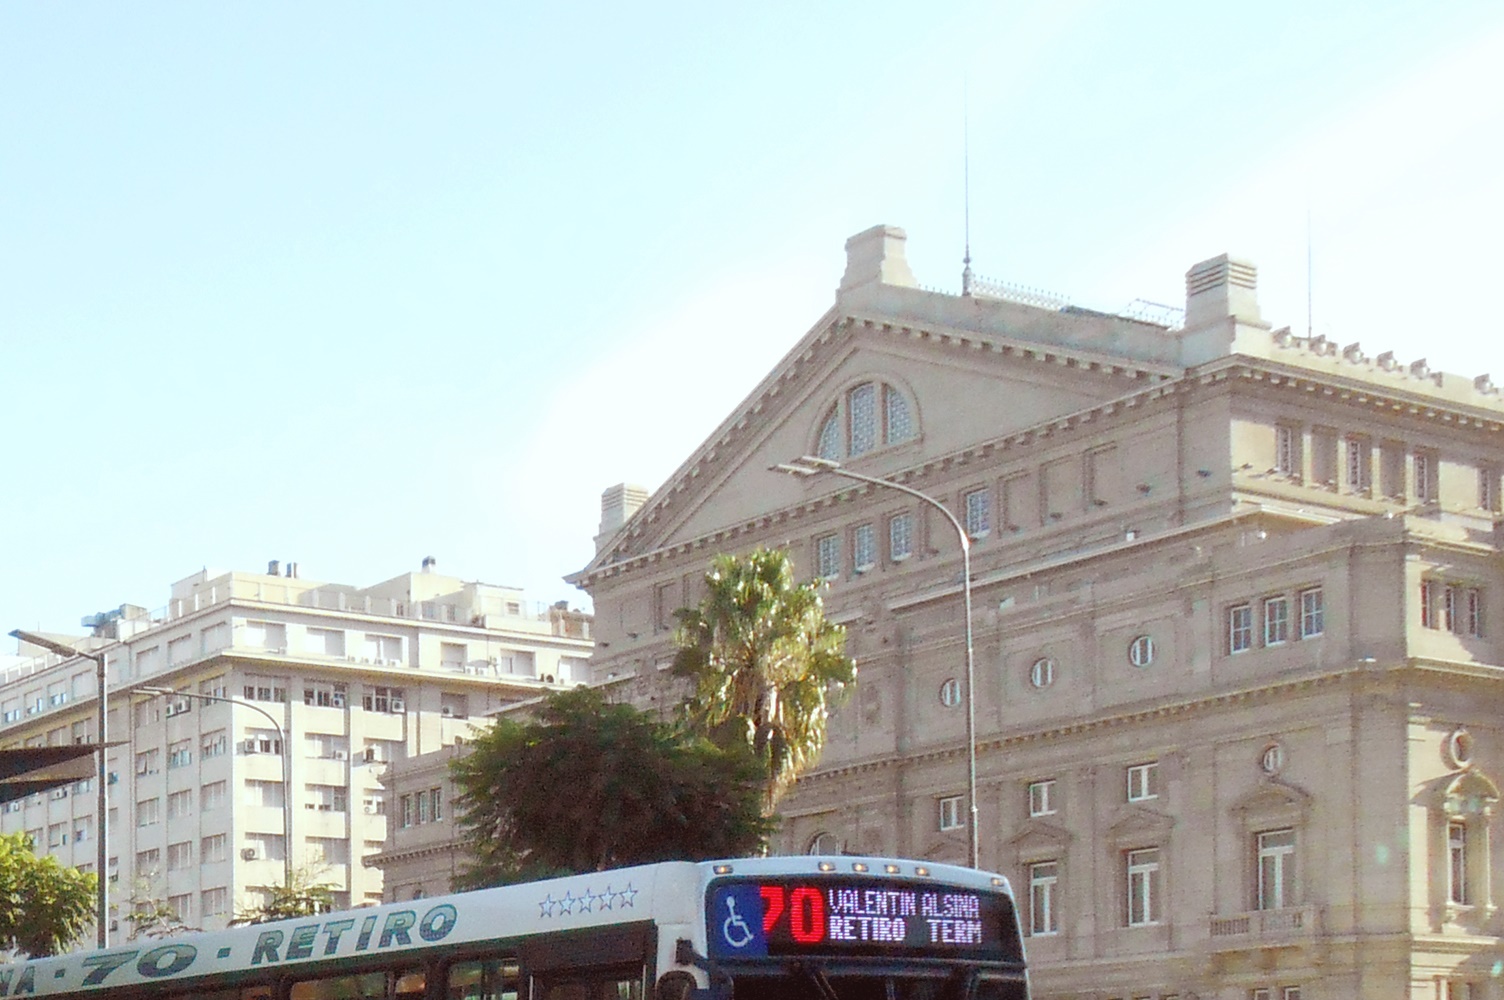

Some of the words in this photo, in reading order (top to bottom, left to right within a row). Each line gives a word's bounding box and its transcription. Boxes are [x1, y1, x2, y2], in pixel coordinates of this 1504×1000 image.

[760, 886, 825, 943] 70
[828, 889, 916, 916] VALENTIN
[921, 893, 980, 918] ALSINA
[81, 944, 198, 987] 70
[251, 903, 458, 965] RETIRO
[829, 916, 907, 942] RETIRO
[926, 919, 983, 944] TERM
